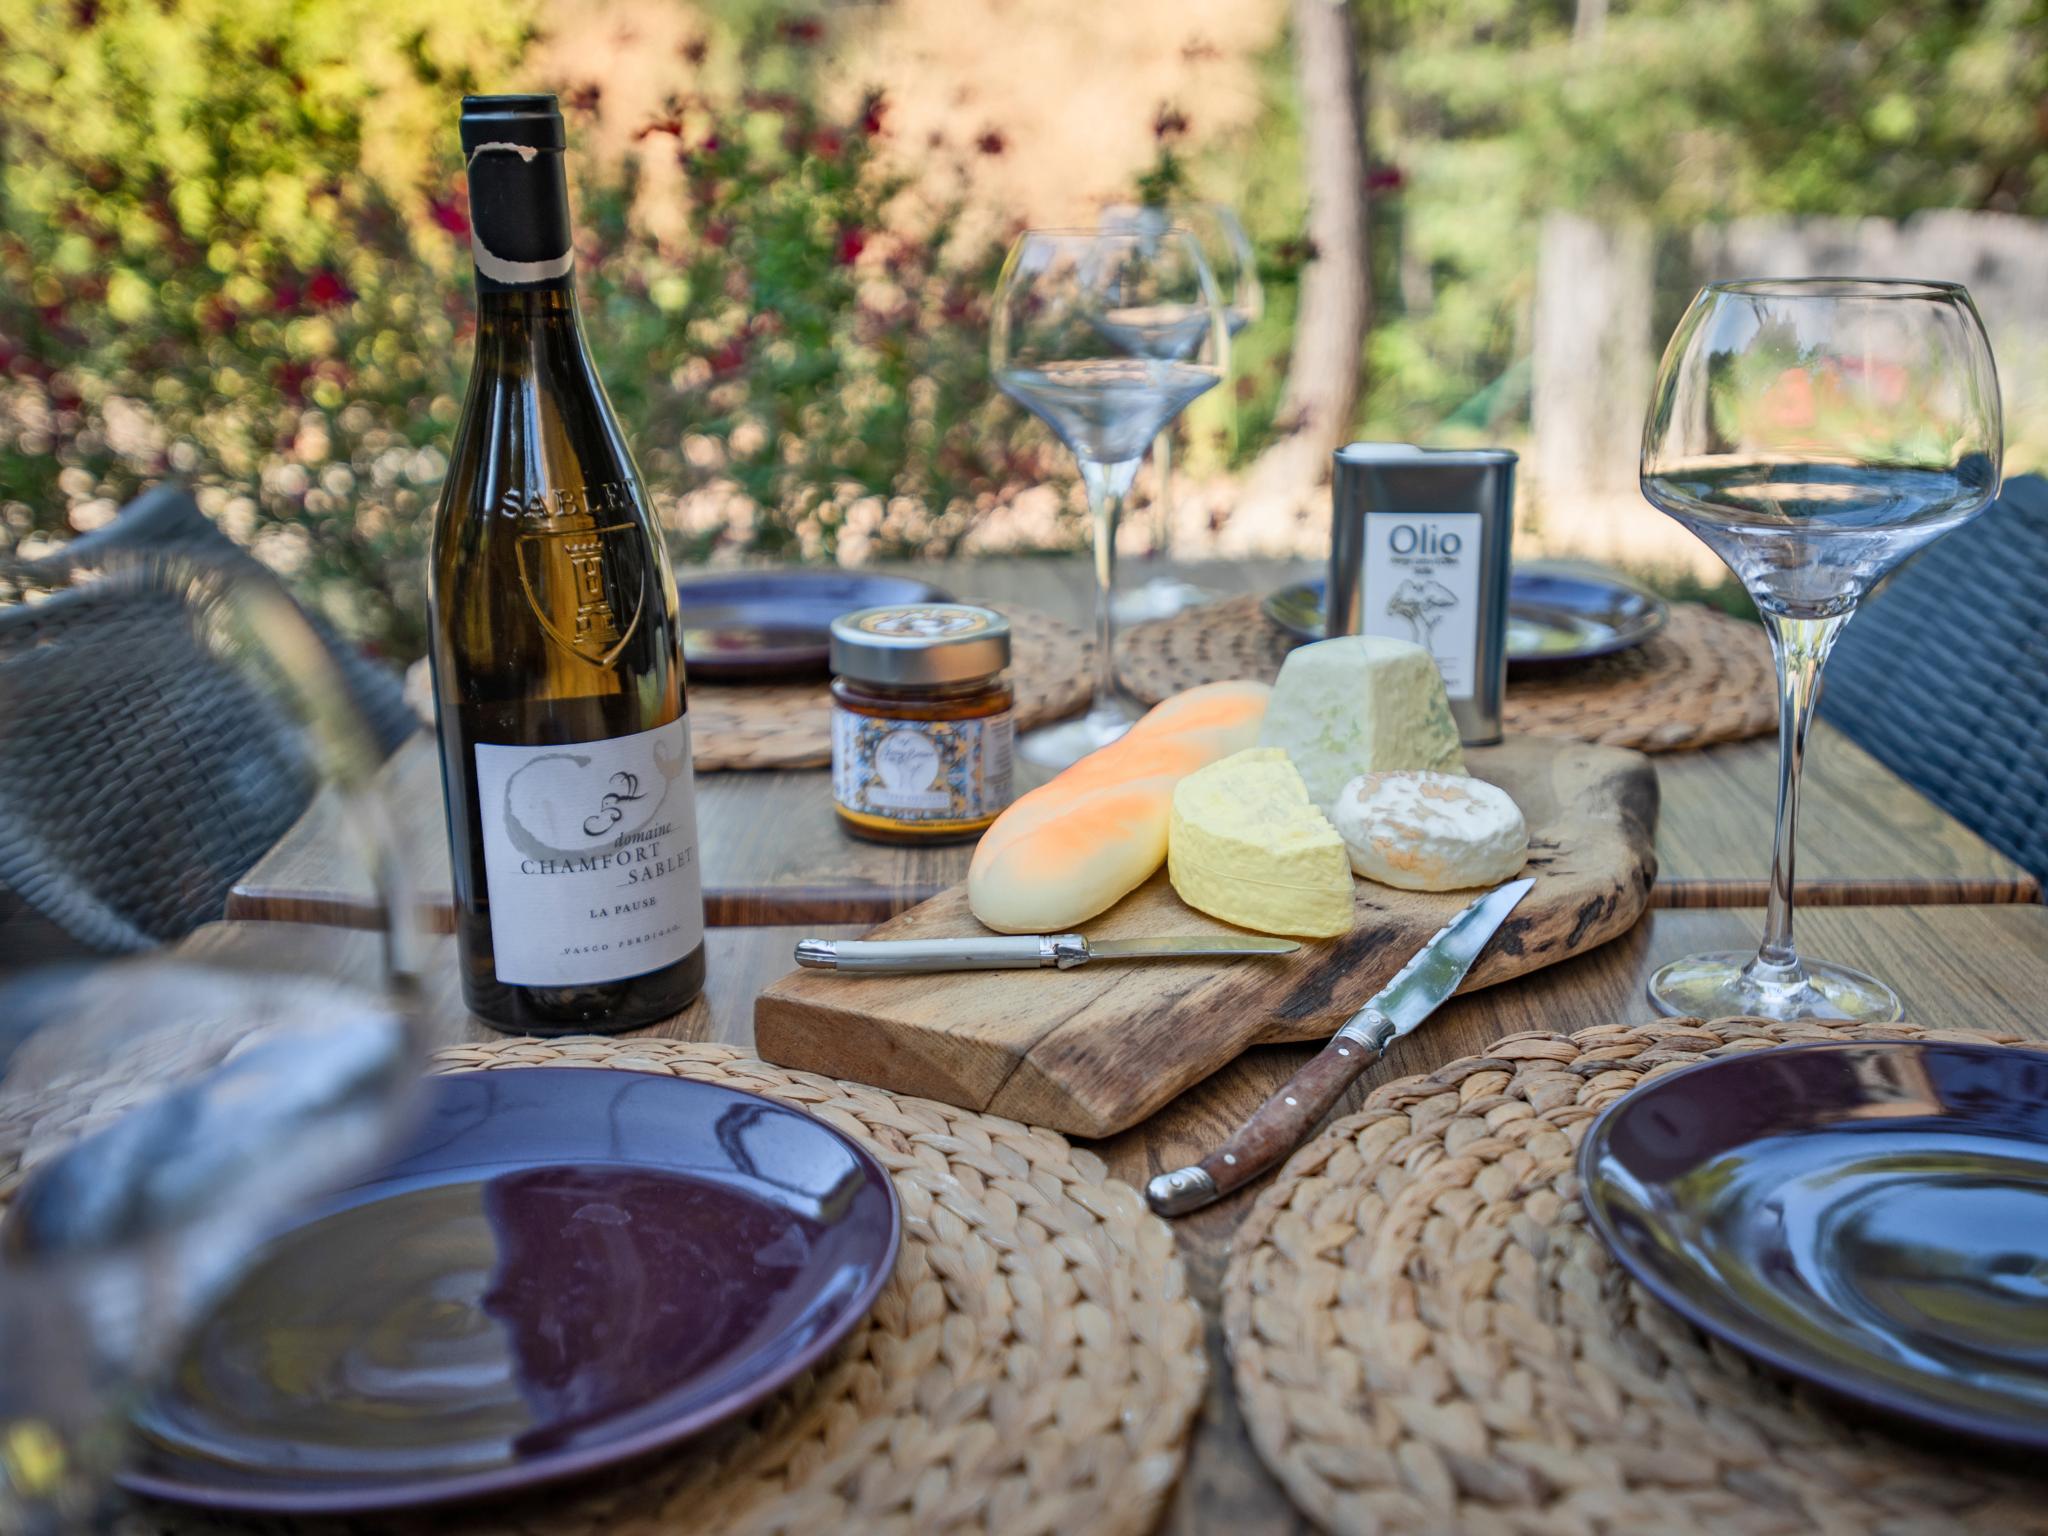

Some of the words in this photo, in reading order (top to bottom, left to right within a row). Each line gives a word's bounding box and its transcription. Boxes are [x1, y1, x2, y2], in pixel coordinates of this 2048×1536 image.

[501, 479, 636, 519] SABLET
[1389, 524, 1462, 555] Olio
[614, 822, 673, 849] domaine
[520, 841, 661, 876] CHAMFORT
[628, 847, 693, 885] SABLET
[589, 908, 608, 919] LA
[615, 896, 658, 915] PAUSE
[563, 943, 609, 955] VASCO
